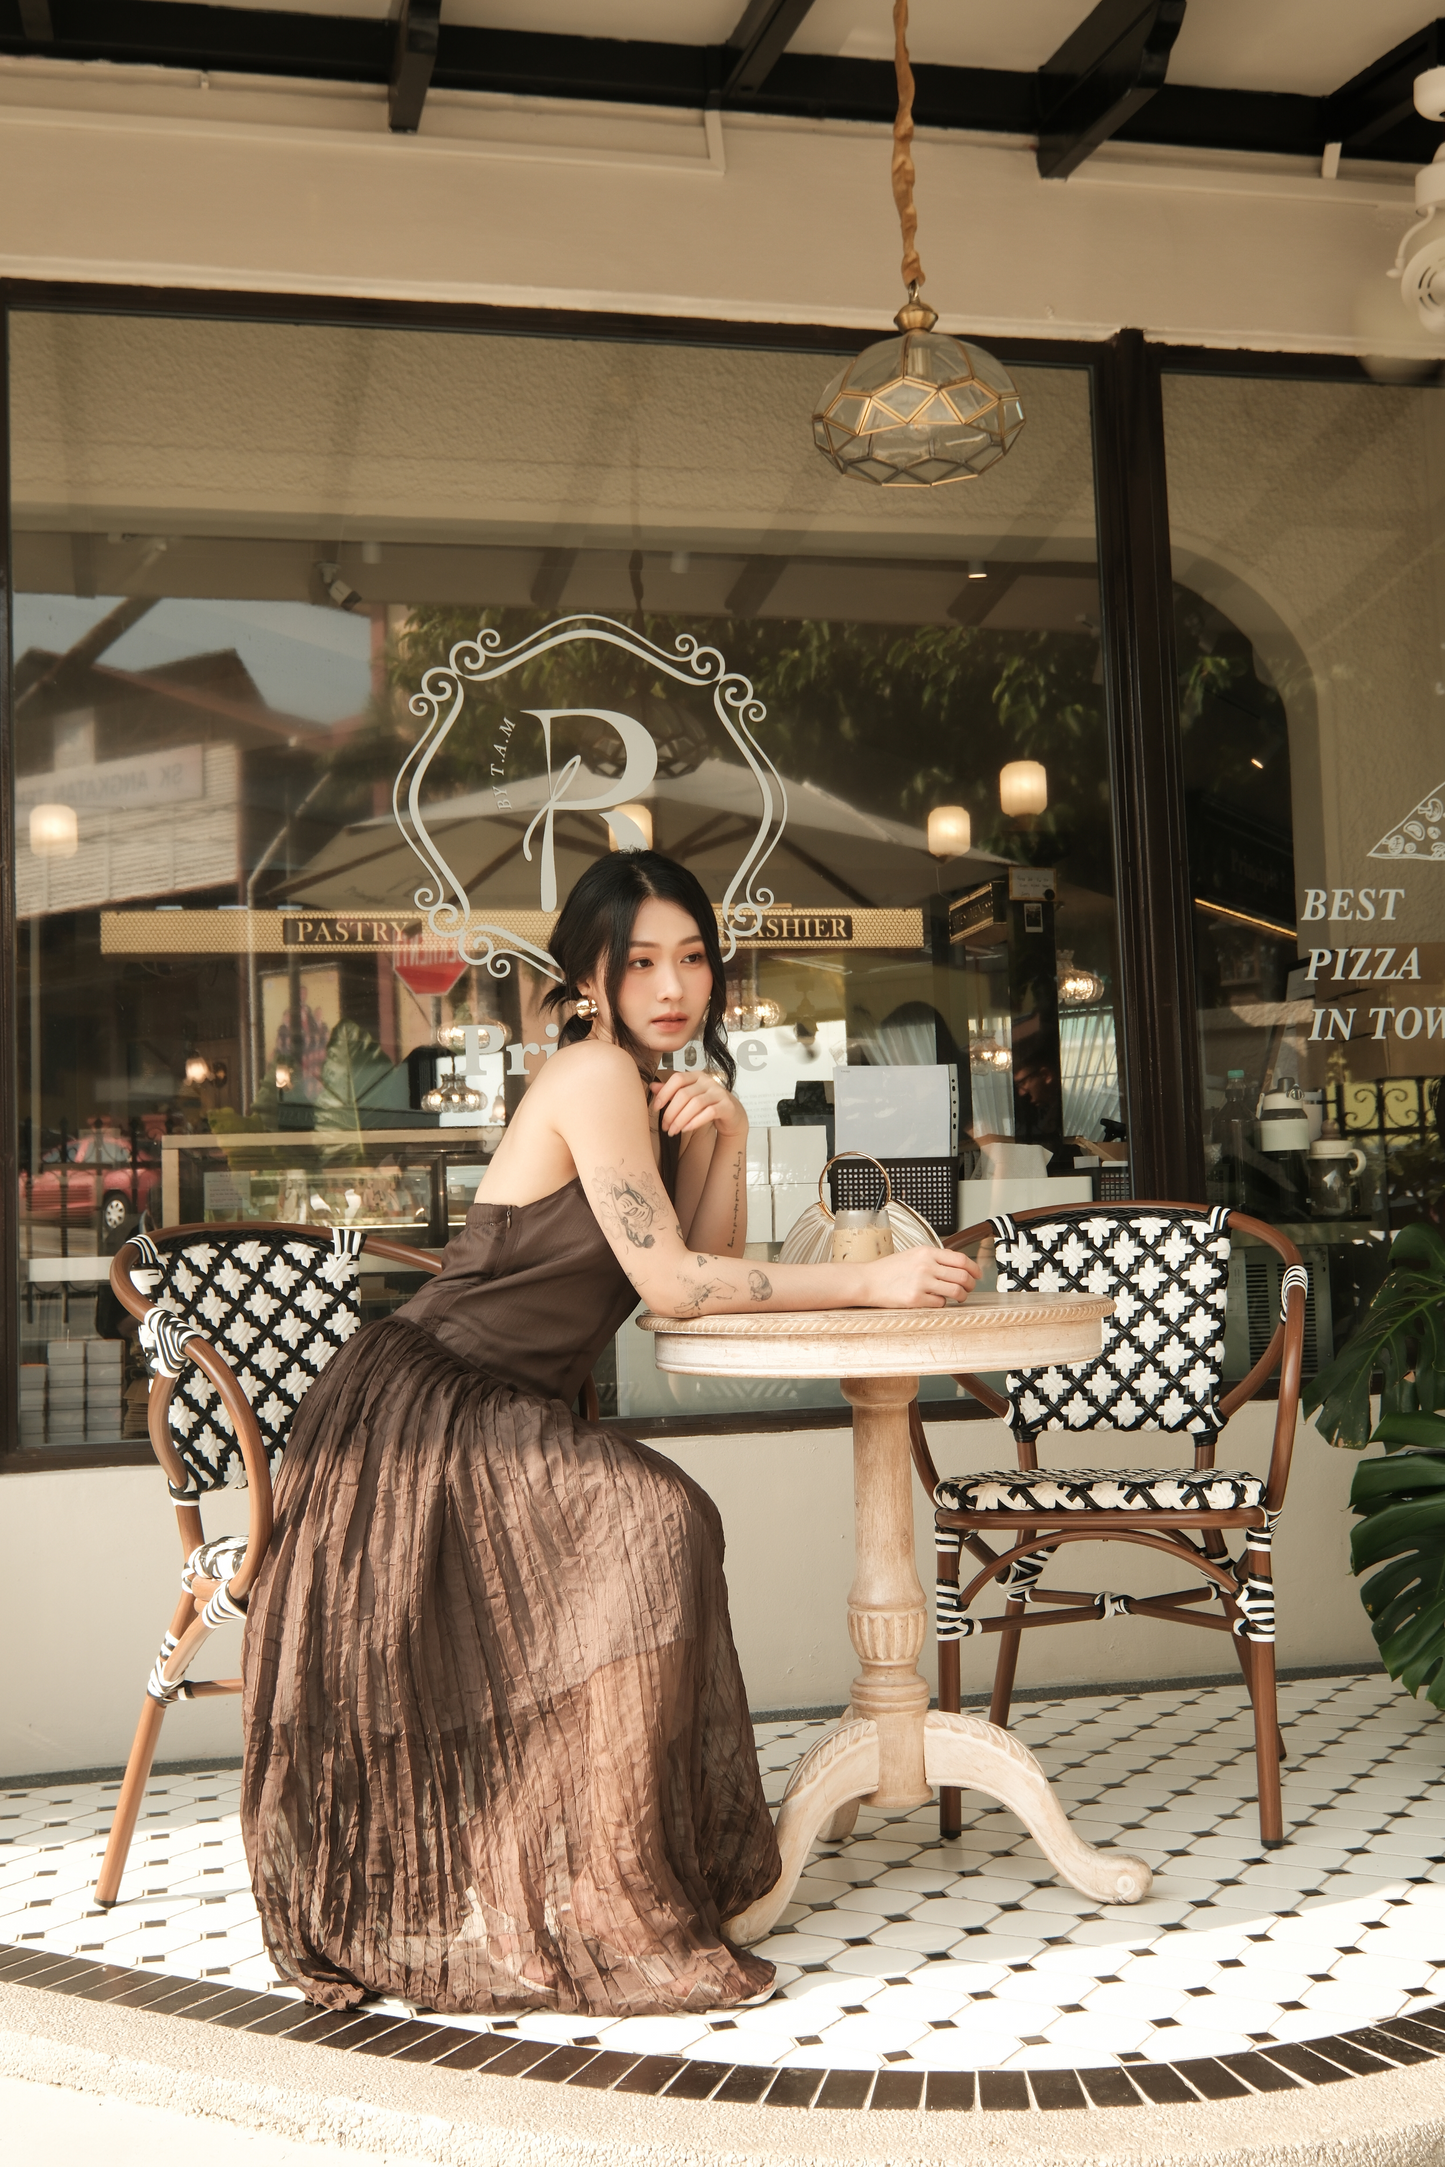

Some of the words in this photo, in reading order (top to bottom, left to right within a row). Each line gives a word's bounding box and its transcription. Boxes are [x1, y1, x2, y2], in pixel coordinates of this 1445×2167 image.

[490, 716, 516, 777] T.A.M
[492, 785, 513, 811] BY
[1301, 889, 1405, 921] BEST
[297, 921, 409, 943] PASTRY
[1305, 947, 1421, 981] PIZZA
[1307, 1008, 1357, 1041] IN
